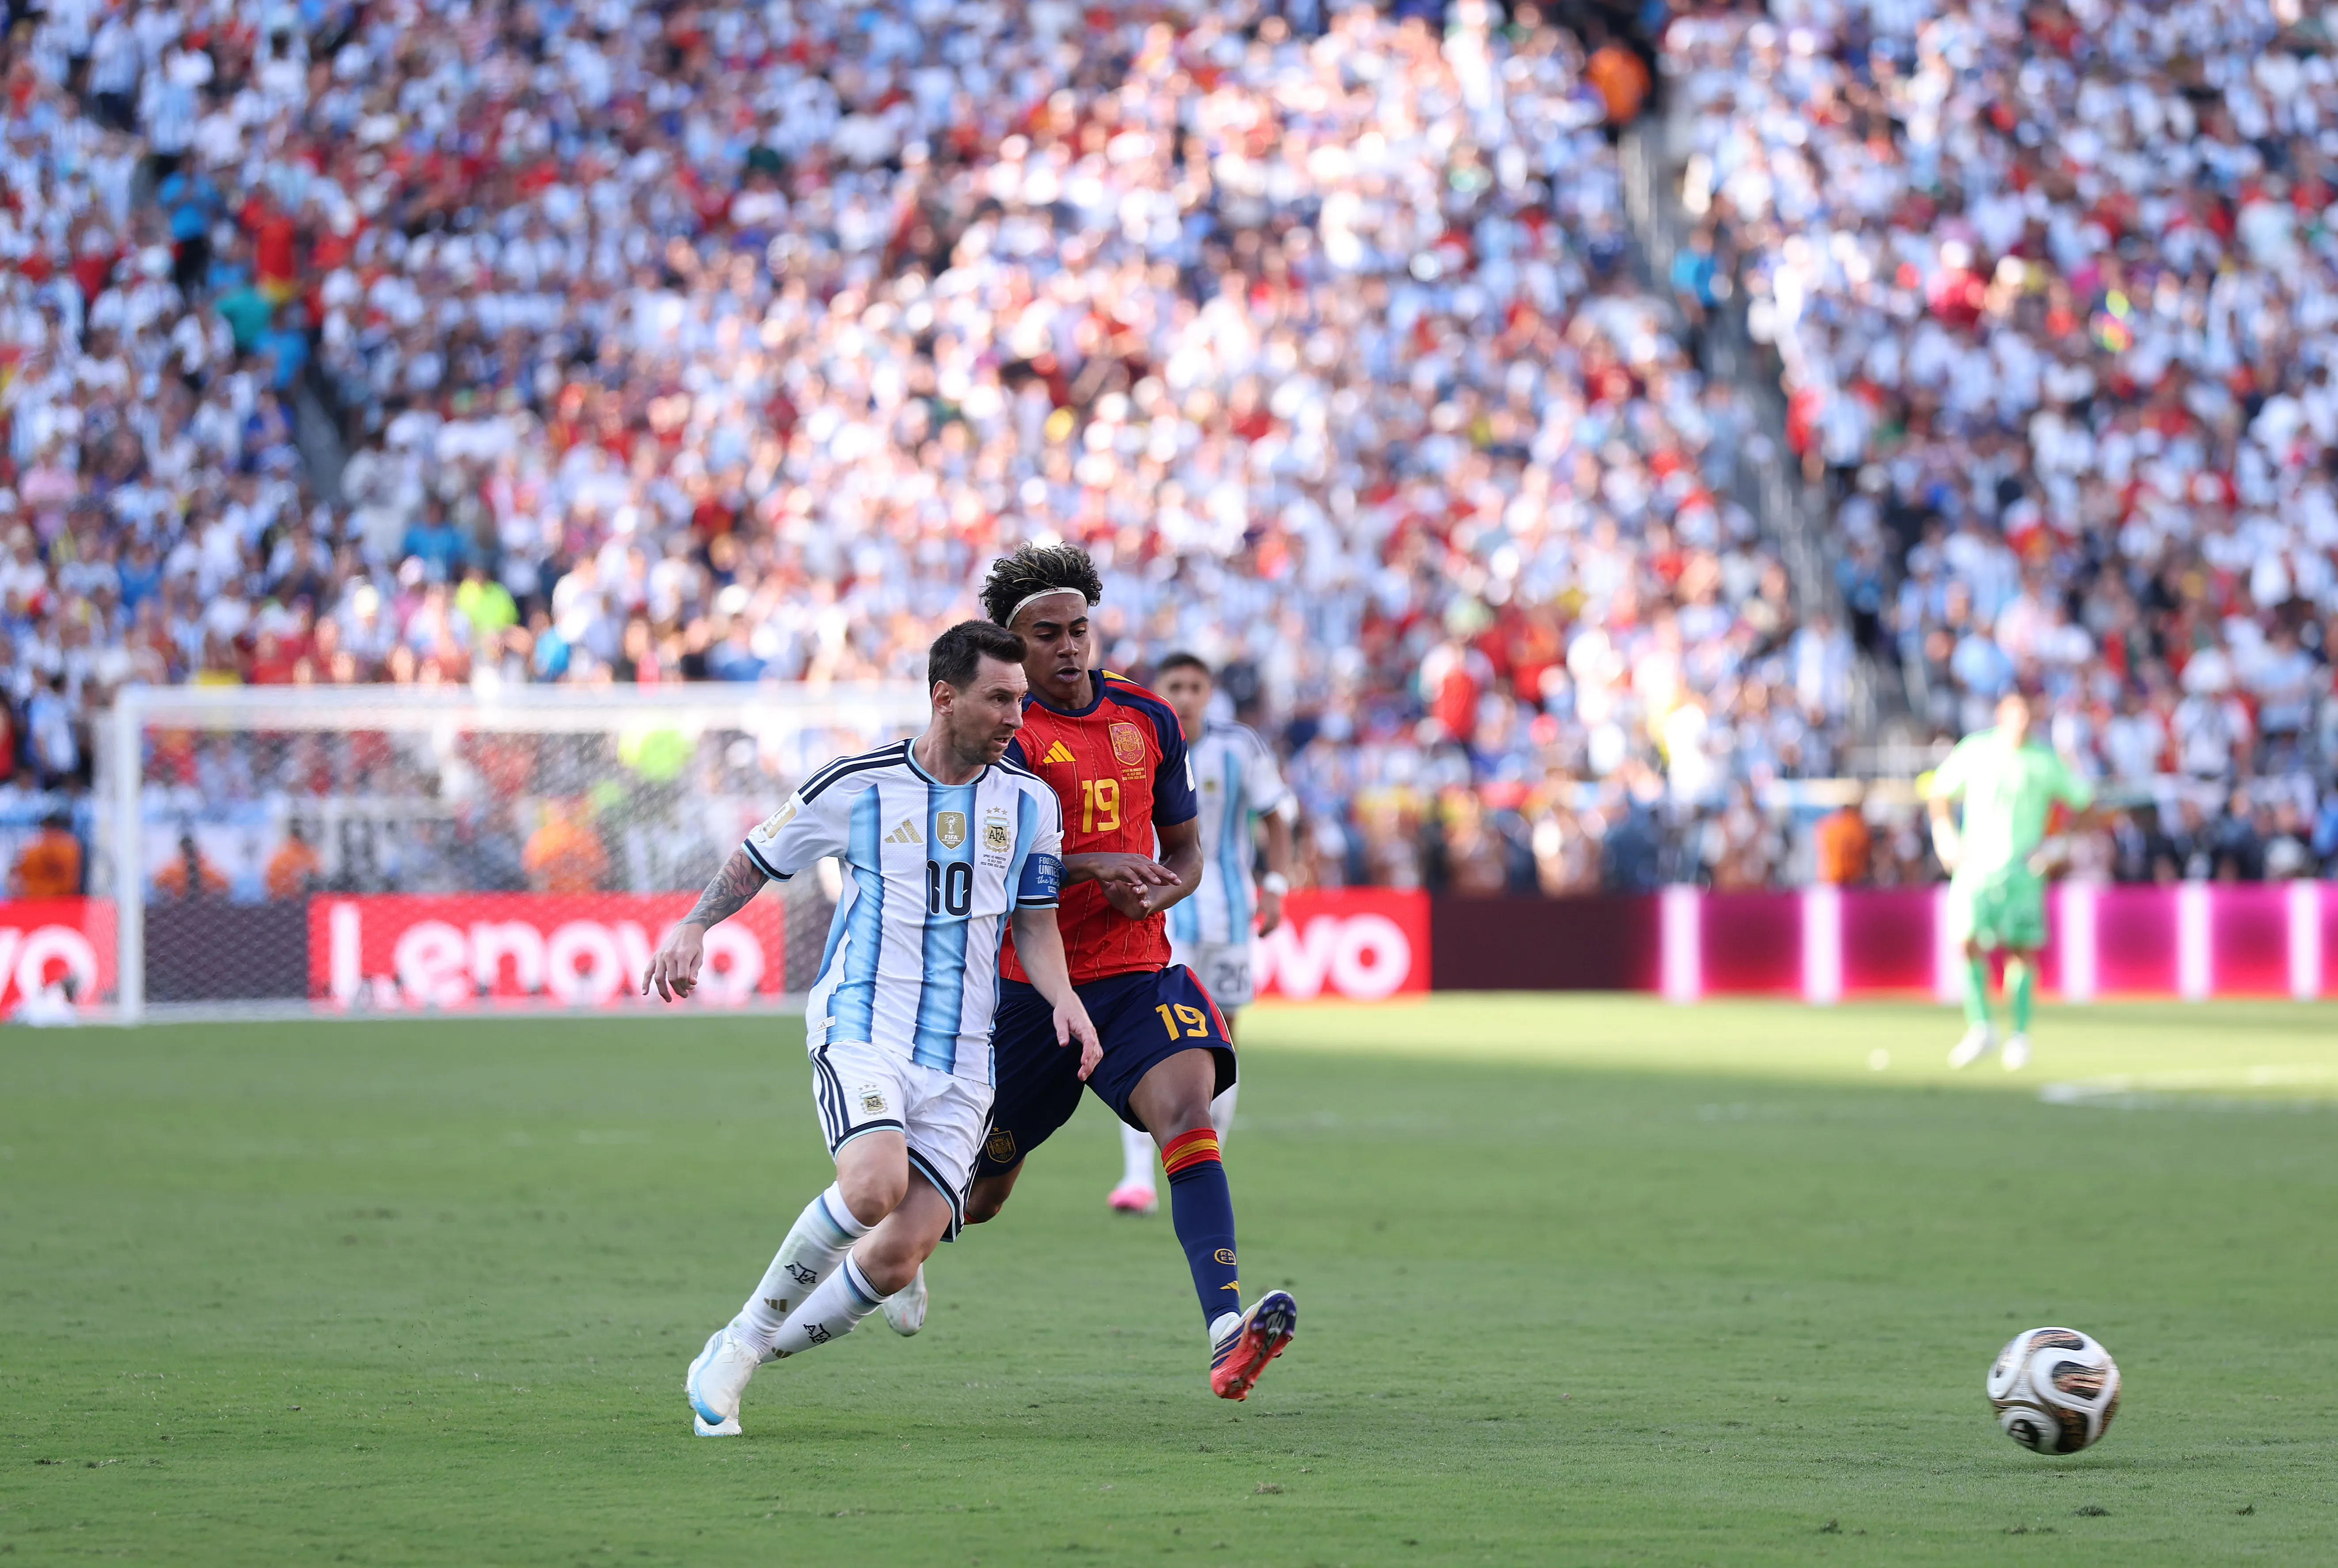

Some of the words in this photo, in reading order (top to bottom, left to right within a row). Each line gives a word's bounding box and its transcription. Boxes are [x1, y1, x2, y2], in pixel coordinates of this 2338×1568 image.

[1082, 778, 1121, 833] 19
[989, 825, 1006, 843] AFA
[1036, 875, 1049, 884] the
[1039, 864, 1060, 878] UNITES
[927, 859, 974, 917] 10
[329, 901, 764, 1011] Lenovo
[1155, 1003, 1209, 1041] 19
[784, 1261, 817, 1284] AFA
[803, 1323, 831, 1344] AFA
